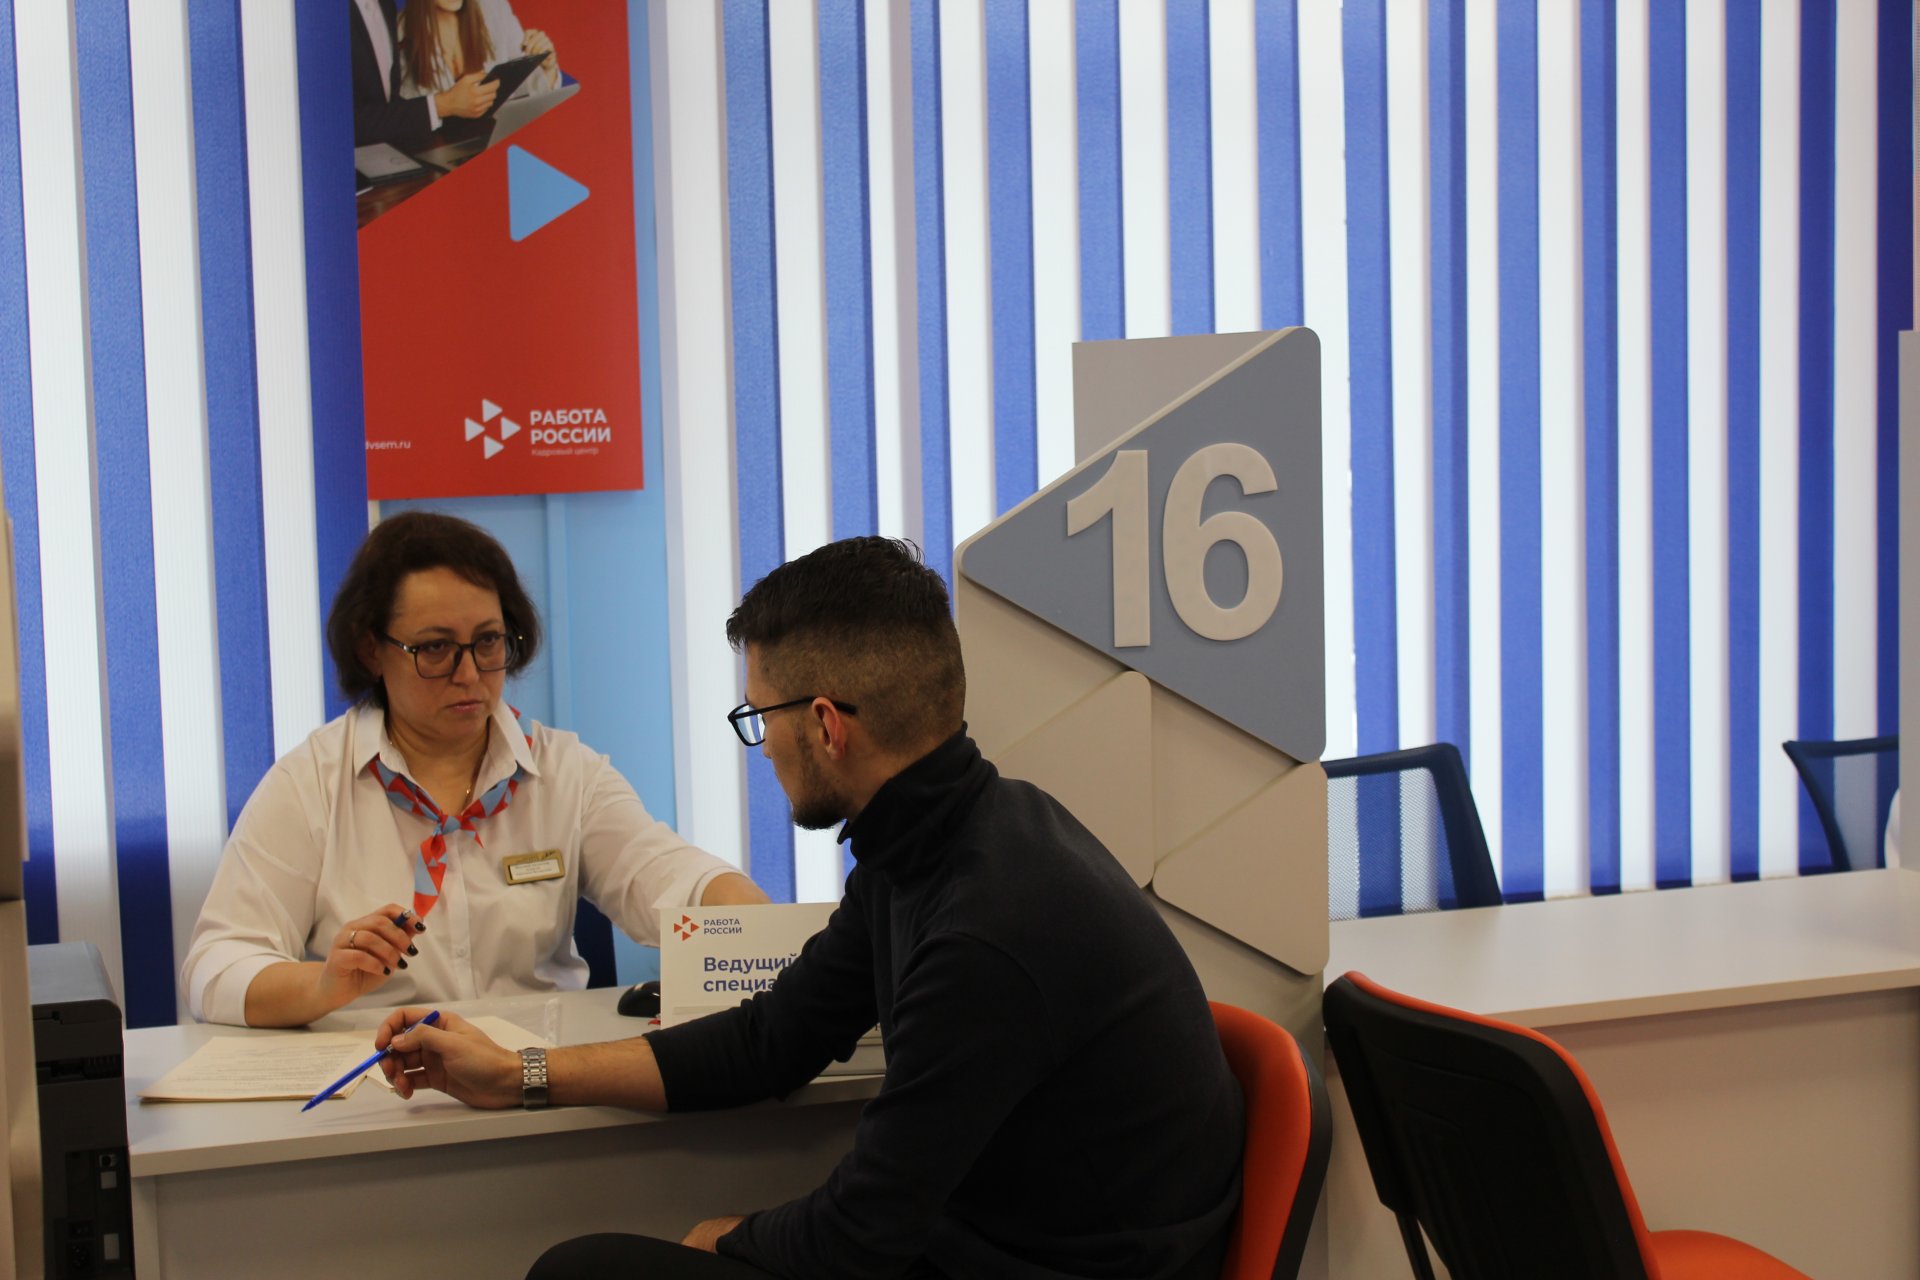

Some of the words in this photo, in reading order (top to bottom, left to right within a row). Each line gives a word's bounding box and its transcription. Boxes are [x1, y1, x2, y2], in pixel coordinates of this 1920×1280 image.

[530, 409, 607, 425] РАБОТА
[530, 426, 611, 445] РОССИИ
[1066, 442, 1283, 648] 16
[704, 919, 740, 927] РАБОТА
[704, 927, 742, 935] РОССИИ
